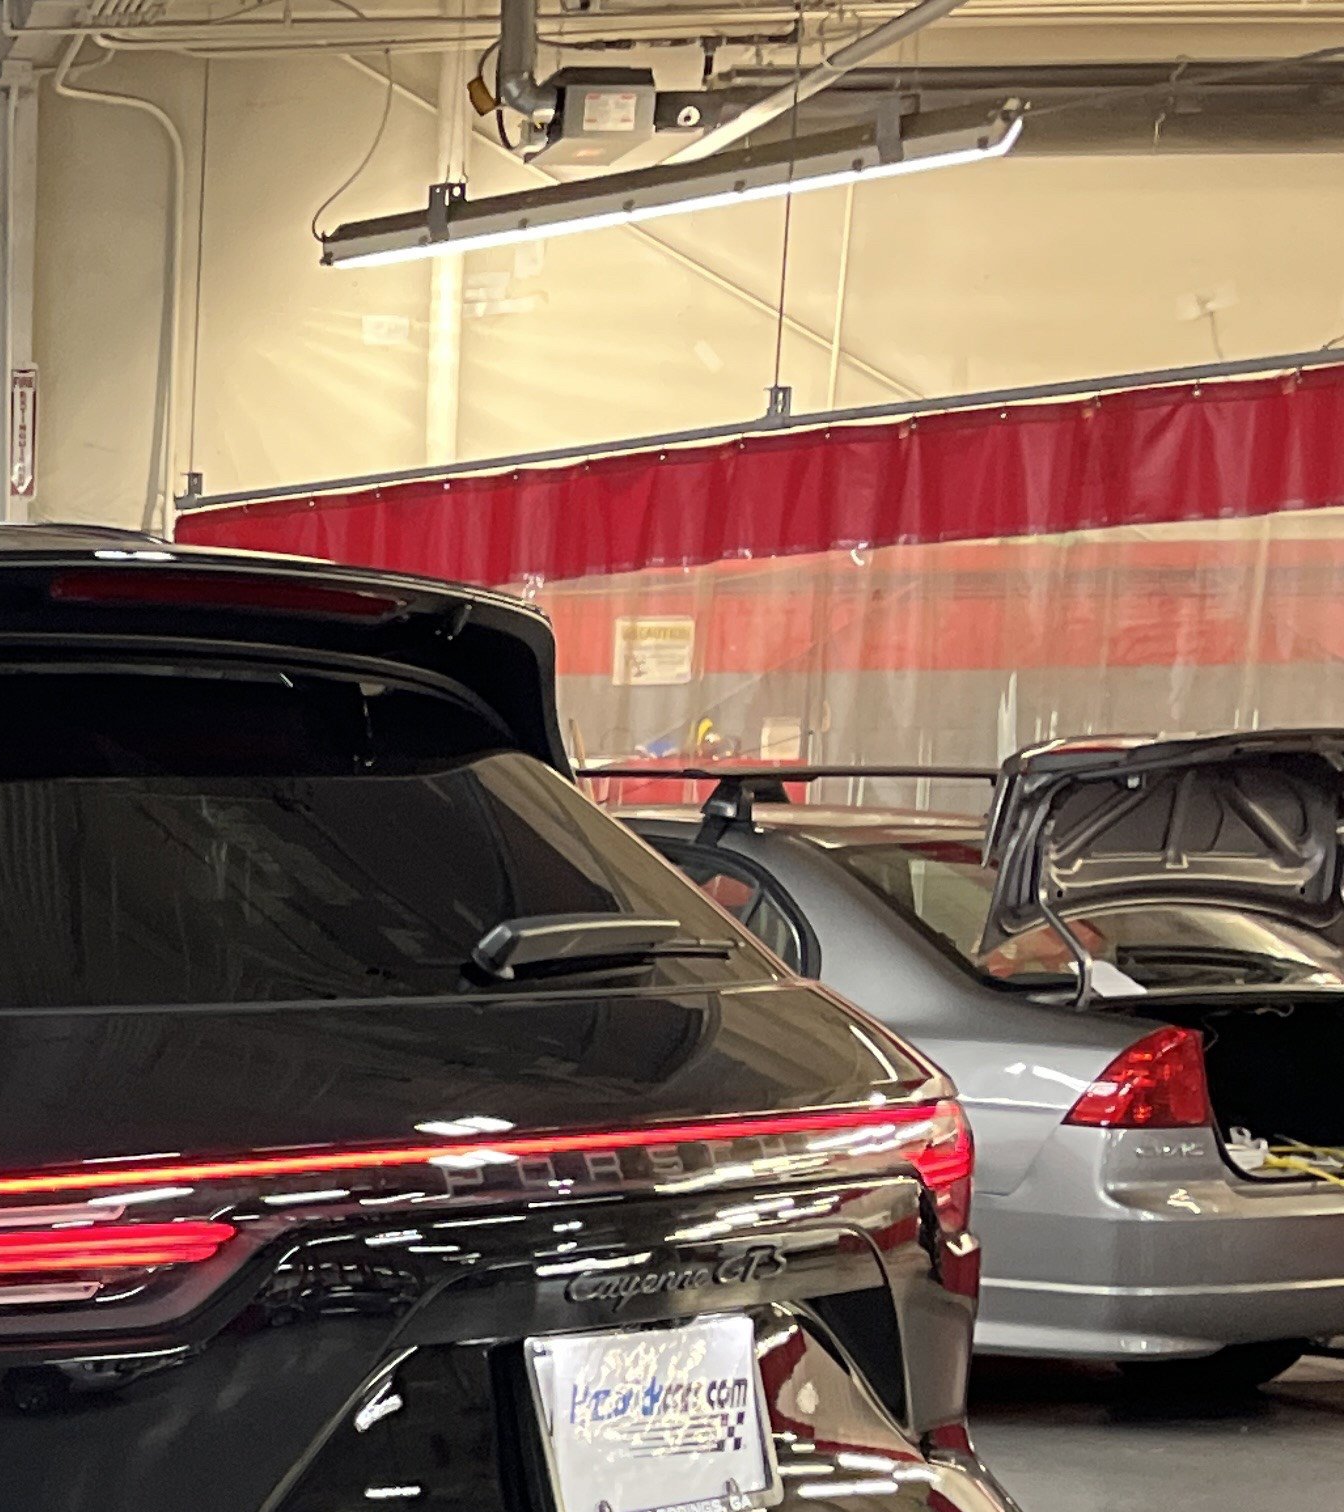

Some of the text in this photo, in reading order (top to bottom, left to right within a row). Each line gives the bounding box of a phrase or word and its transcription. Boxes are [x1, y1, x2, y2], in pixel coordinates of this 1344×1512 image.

[441, 1134, 822, 1198] PORSCH
[566, 1245, 788, 1313] Cayenne GTS
[729, 1495, 754, 1511] GA
